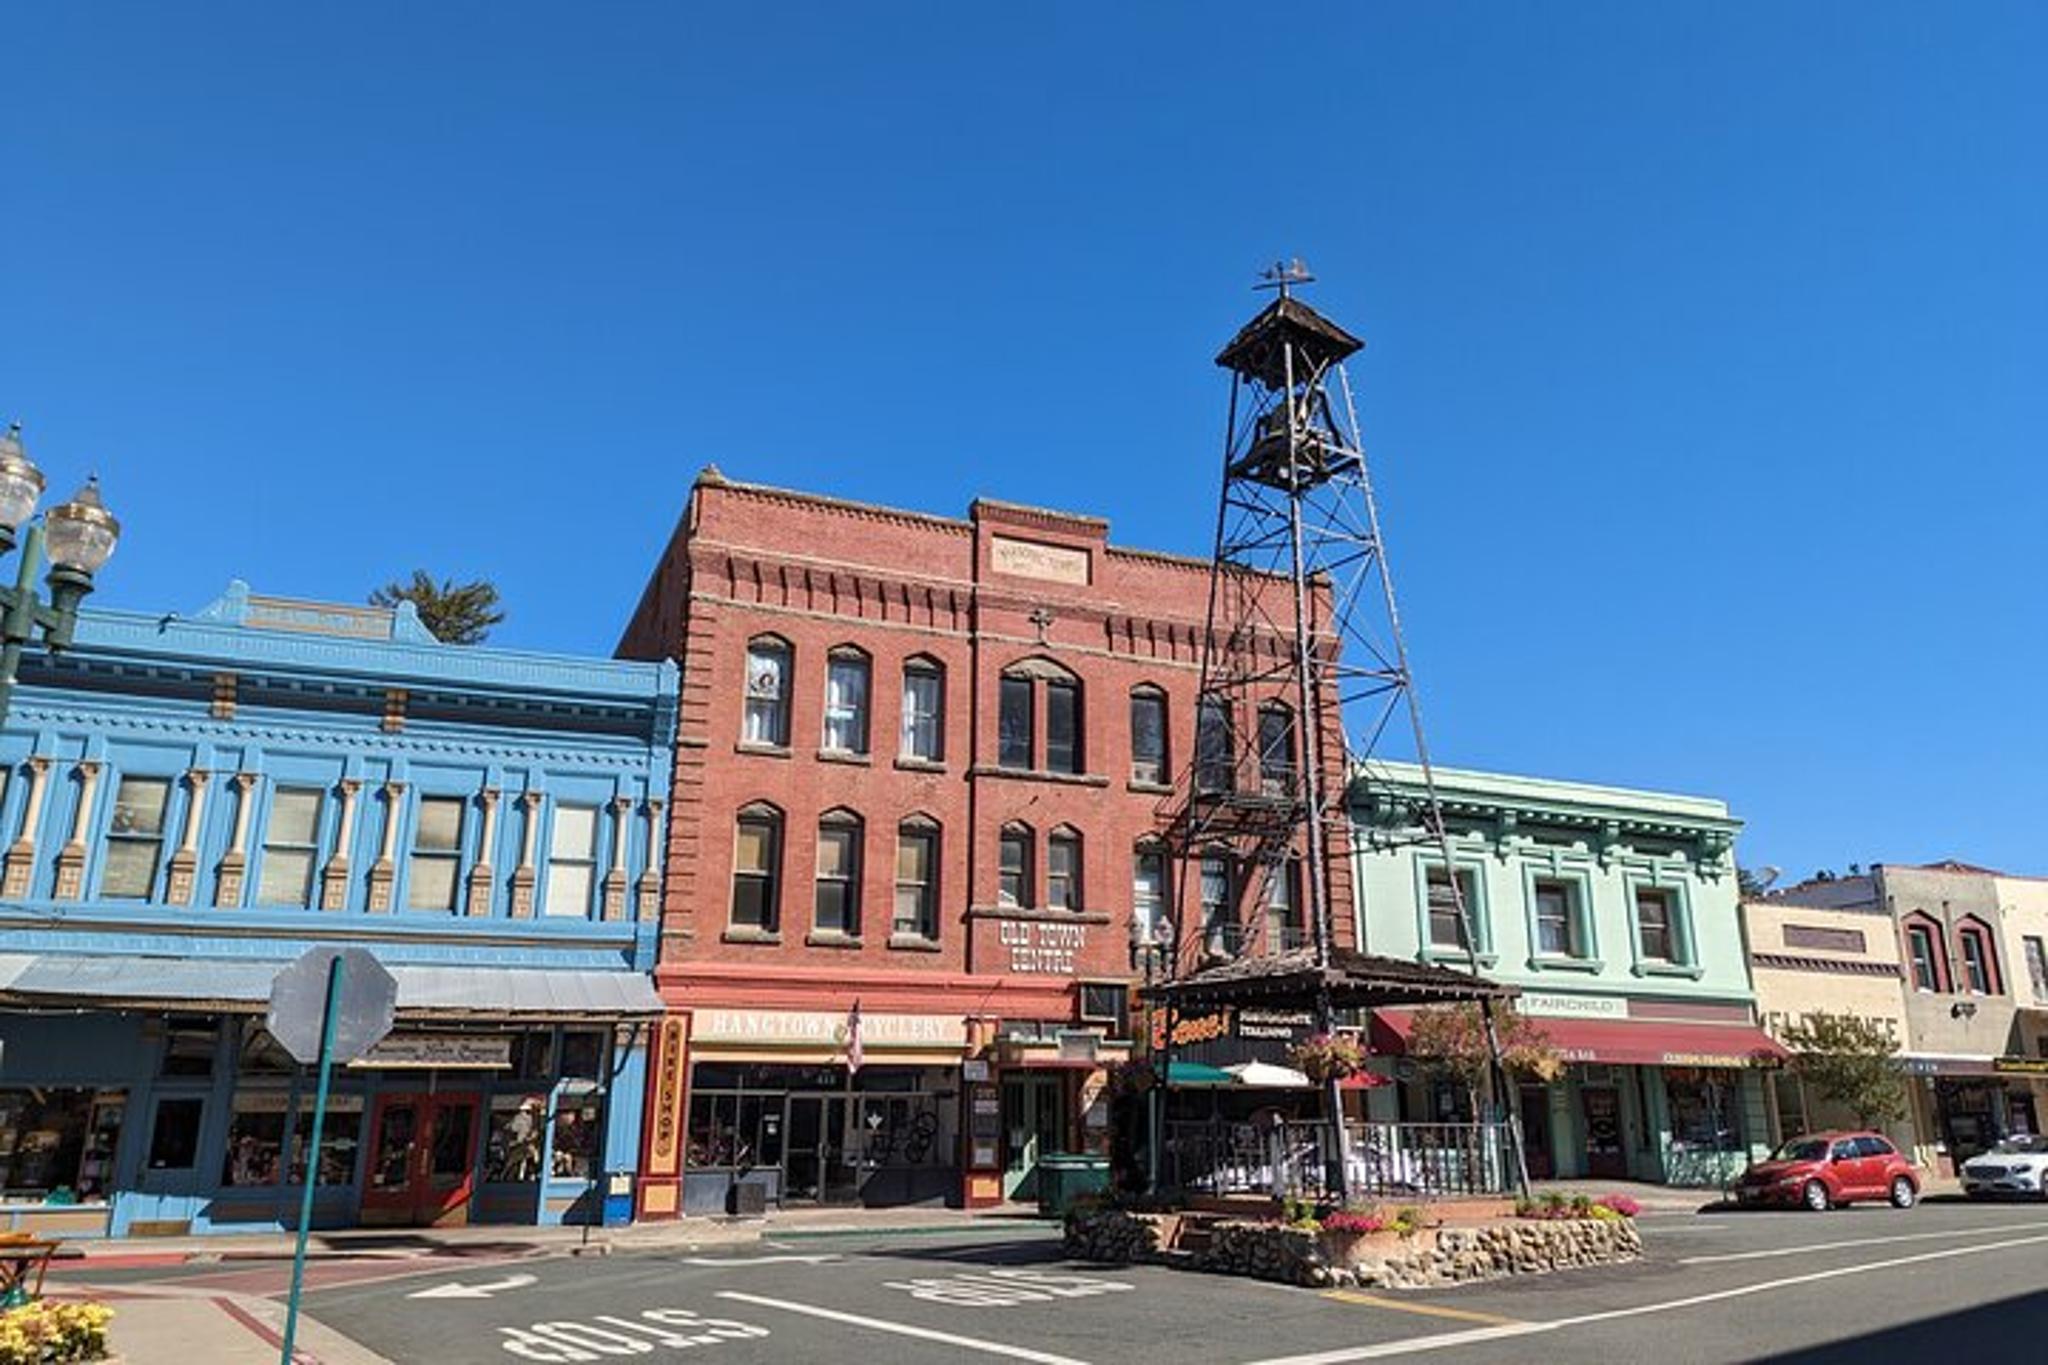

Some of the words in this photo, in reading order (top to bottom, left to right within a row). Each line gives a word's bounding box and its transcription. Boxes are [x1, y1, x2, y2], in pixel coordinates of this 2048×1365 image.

[1000, 921, 1029, 945] OLD
[1038, 923, 1085, 948] TOWN
[1011, 947, 1074, 972] CENTRE
[711, 1014, 836, 1038] HANGTOWN
[497, 1308, 771, 1363] STOP
